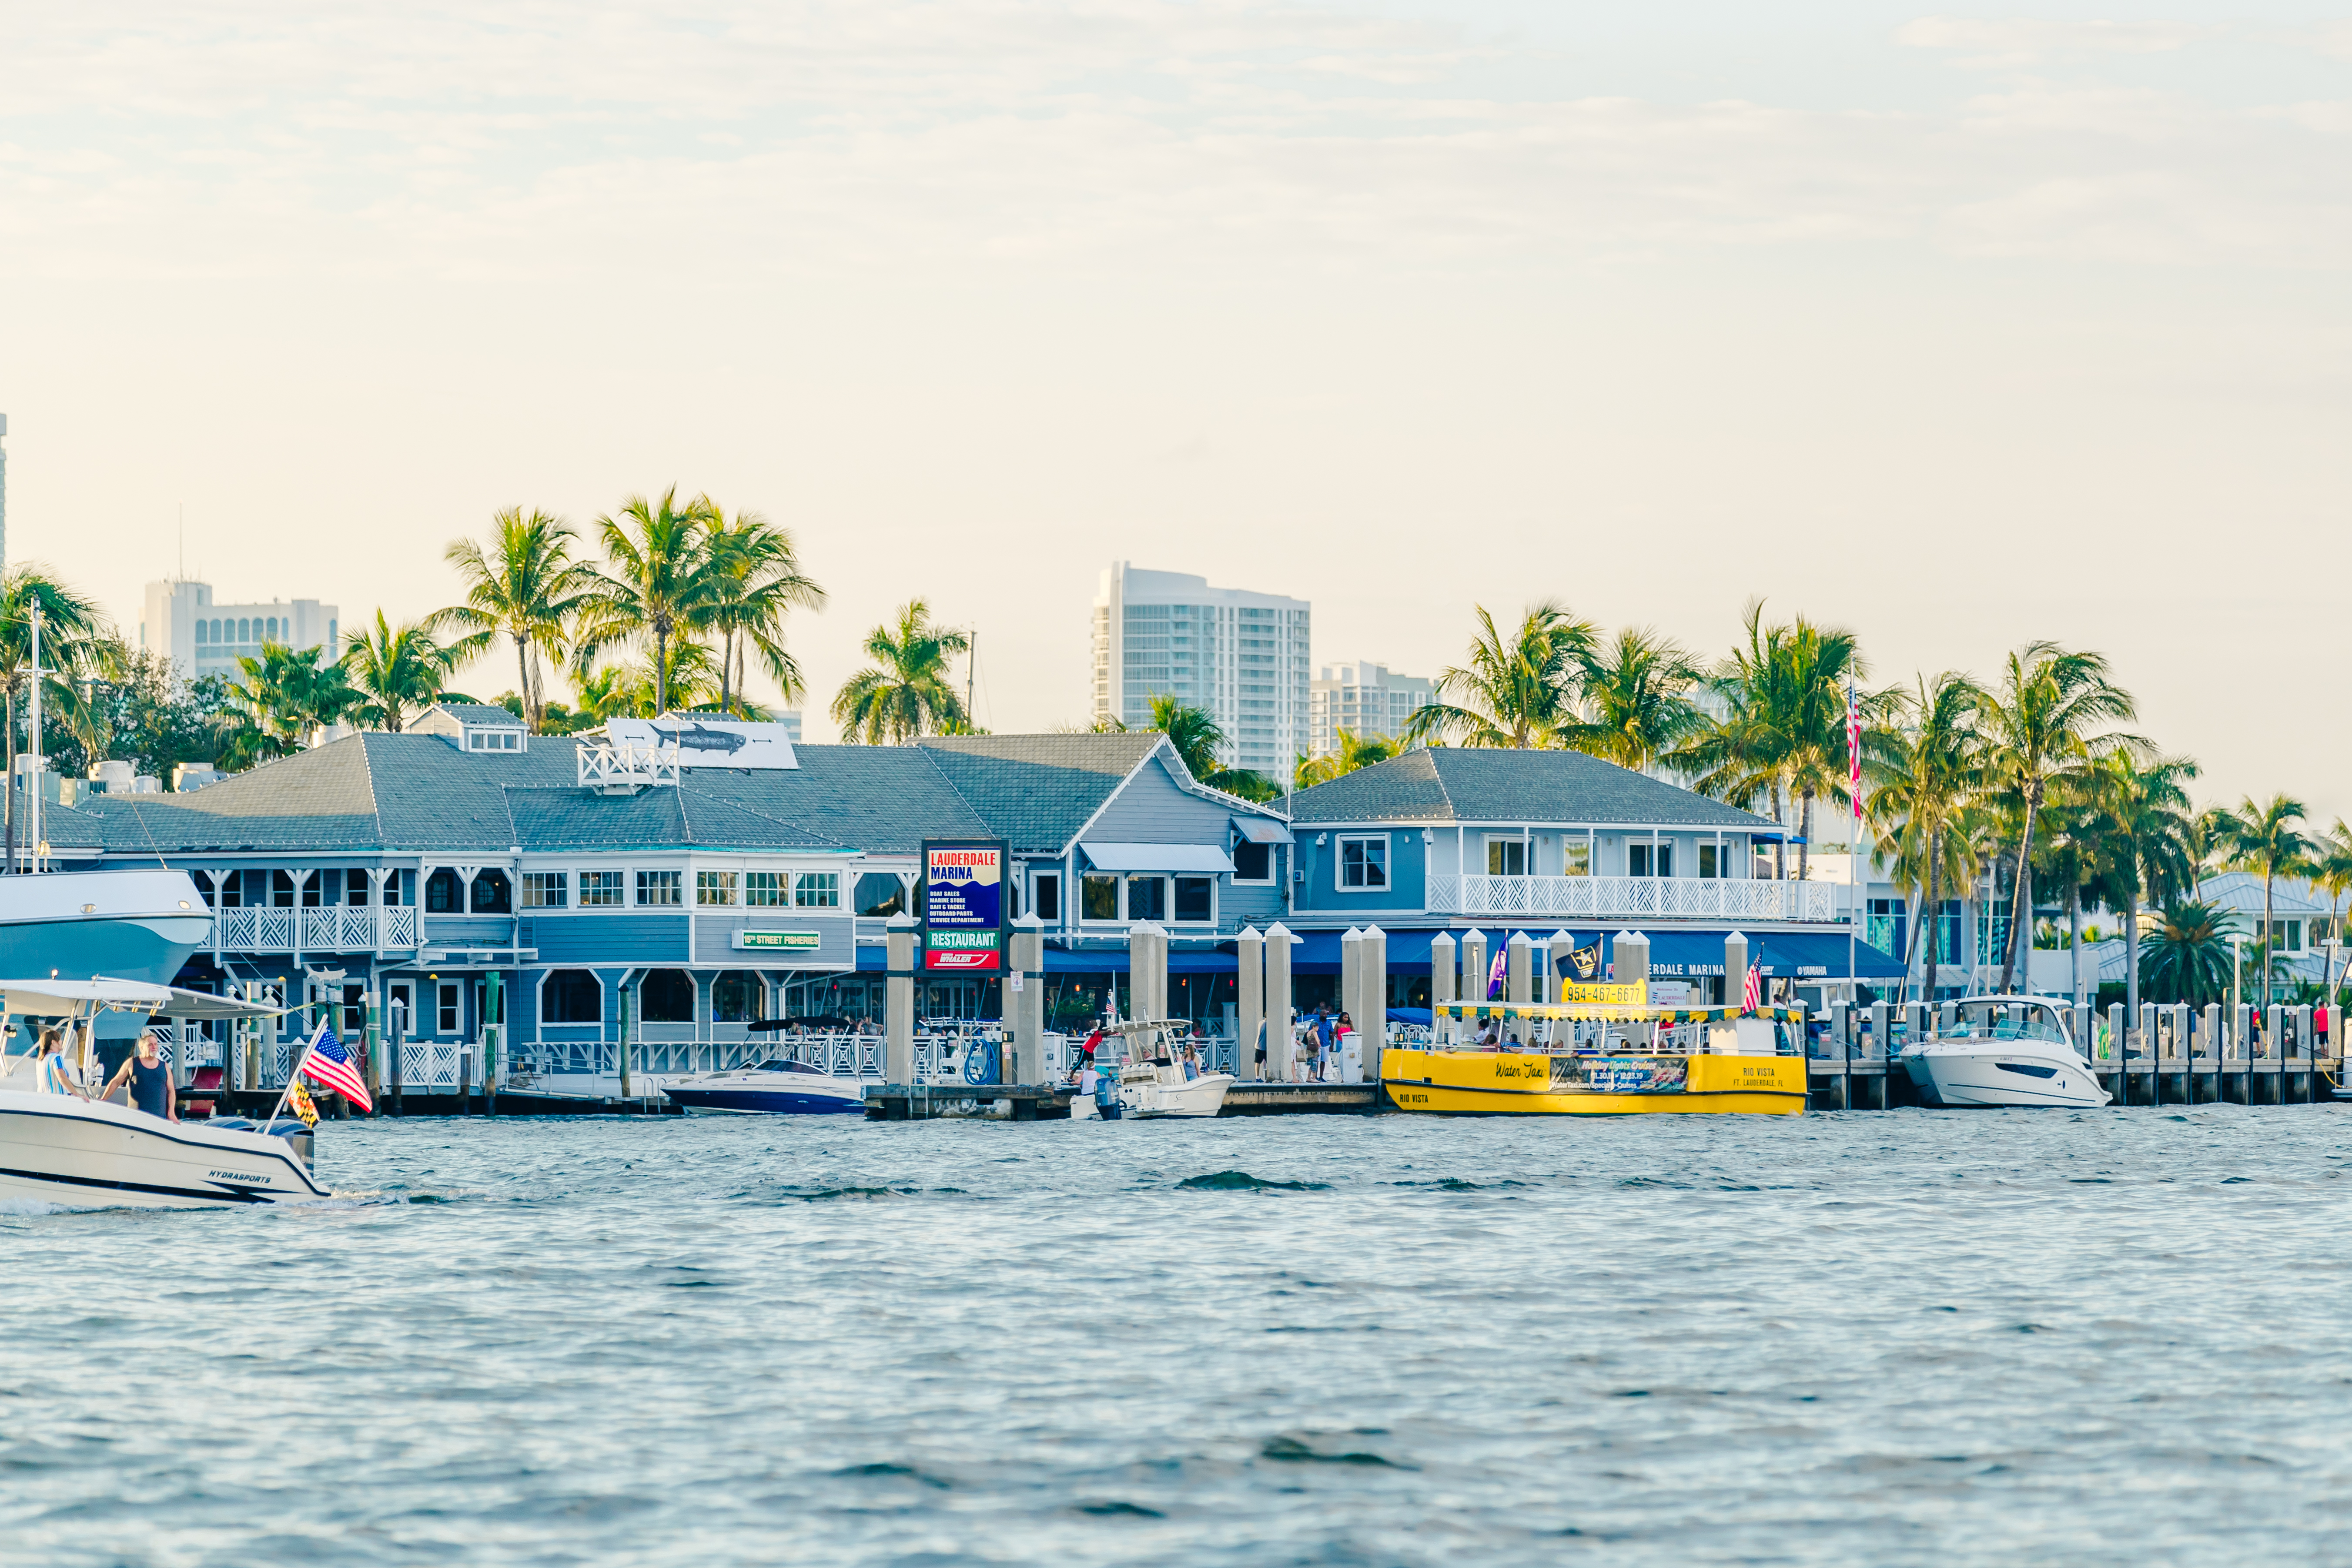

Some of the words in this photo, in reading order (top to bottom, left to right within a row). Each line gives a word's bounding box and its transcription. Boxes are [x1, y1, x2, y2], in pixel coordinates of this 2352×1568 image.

[931, 853, 996, 866] LAUDERDALE
[931, 867, 973, 879] MARINA
[756, 936, 783, 944] STREET
[784, 936, 818, 945] FISHERIES
[931, 933, 995, 946] RESTAURANT
[1689, 964, 1725, 975] MARINA
[1802, 966, 1827, 976] YAMAHA
[1568, 987, 1639, 1001] 954-467-6677
[1496, 1062, 1521, 1077] Water
[1524, 1063, 1544, 1078] Taxi
[1582, 1060, 1609, 1072] Holiday
[1609, 1060, 1630, 1071] Lights
[1631, 1060, 1657, 1070] Cruises
[1743, 1068, 1753, 1076] RIO
[1757, 1068, 1774, 1077] VISTA
[1400, 1094, 1409, 1103] RIO
[1412, 1094, 1428, 1103] VISTA
[208, 1170, 271, 1184] HYDRASPORTS
